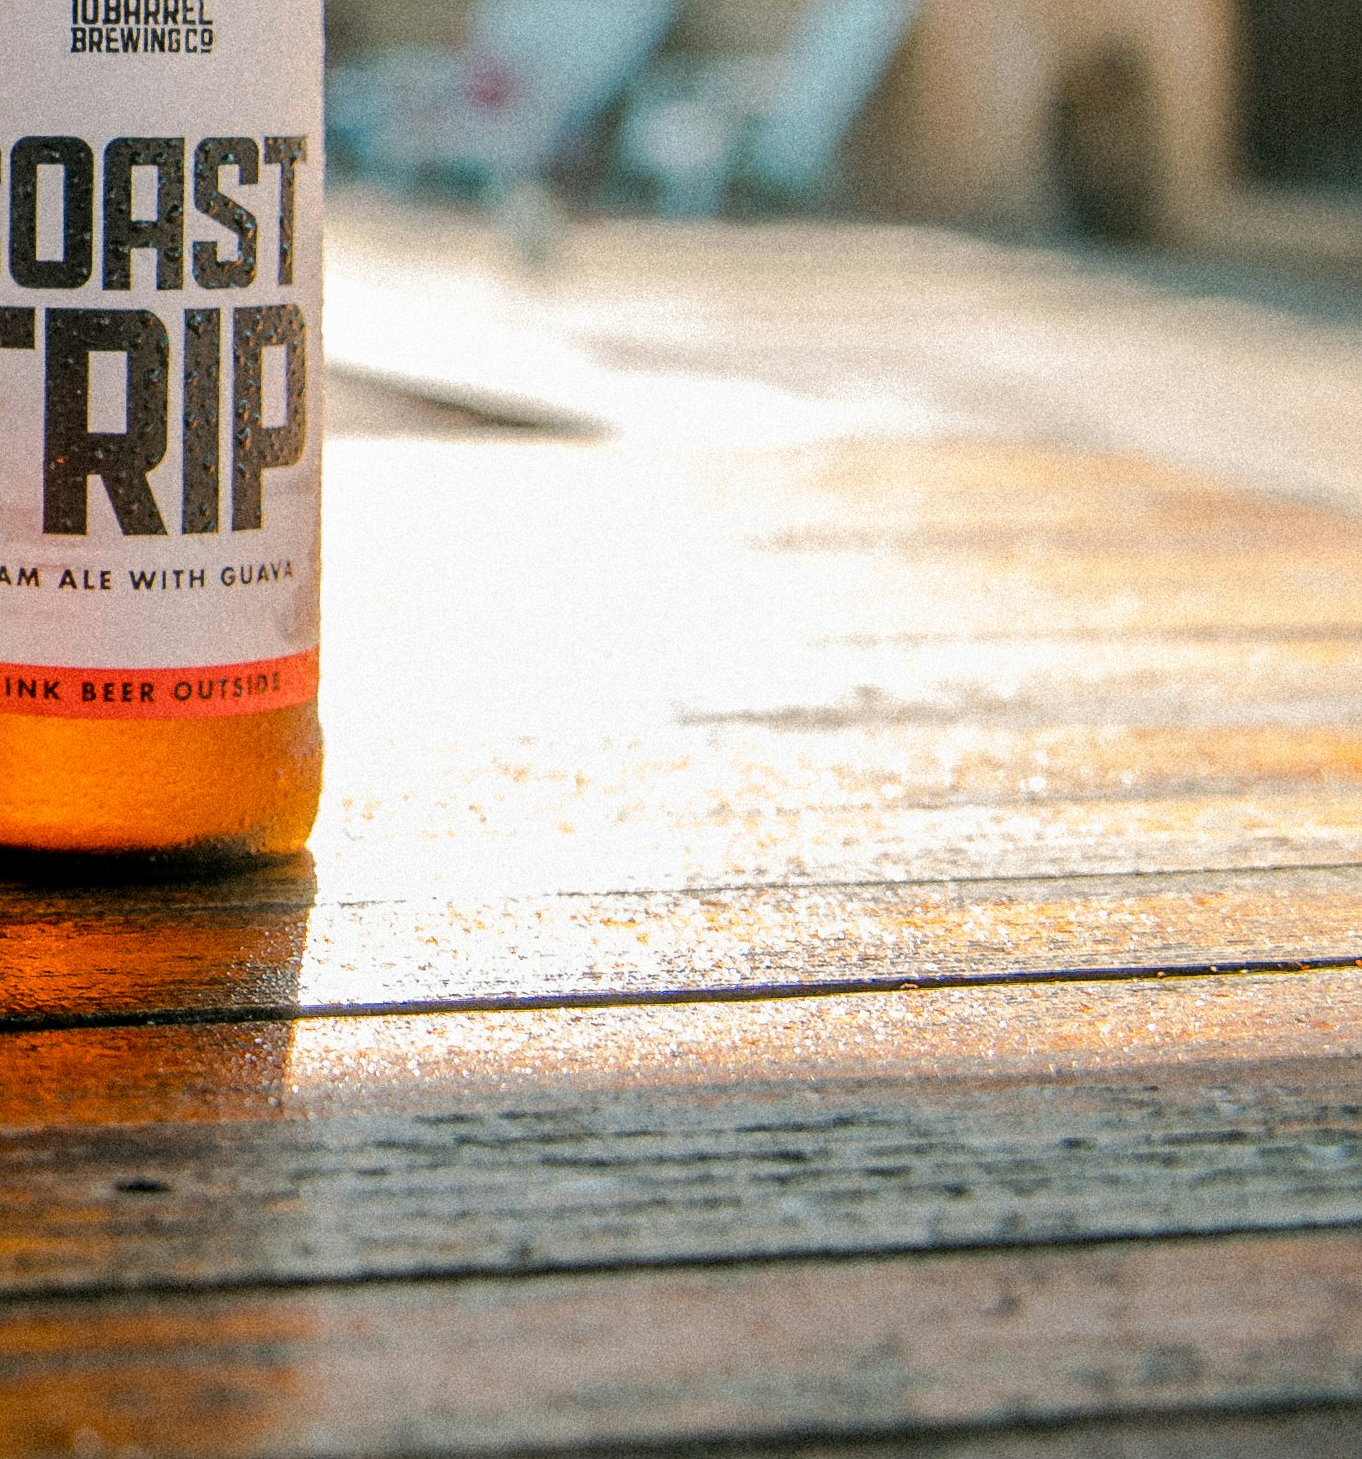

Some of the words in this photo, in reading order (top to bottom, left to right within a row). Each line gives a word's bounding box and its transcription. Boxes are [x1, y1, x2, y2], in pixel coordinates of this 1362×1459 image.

[58, 569, 112, 590] ALE
[129, 569, 206, 590] WITH
[220, 560, 293, 588] GUAVA
[81, 682, 155, 703] BEER
[173, 672, 281, 702] OUTSIDE
